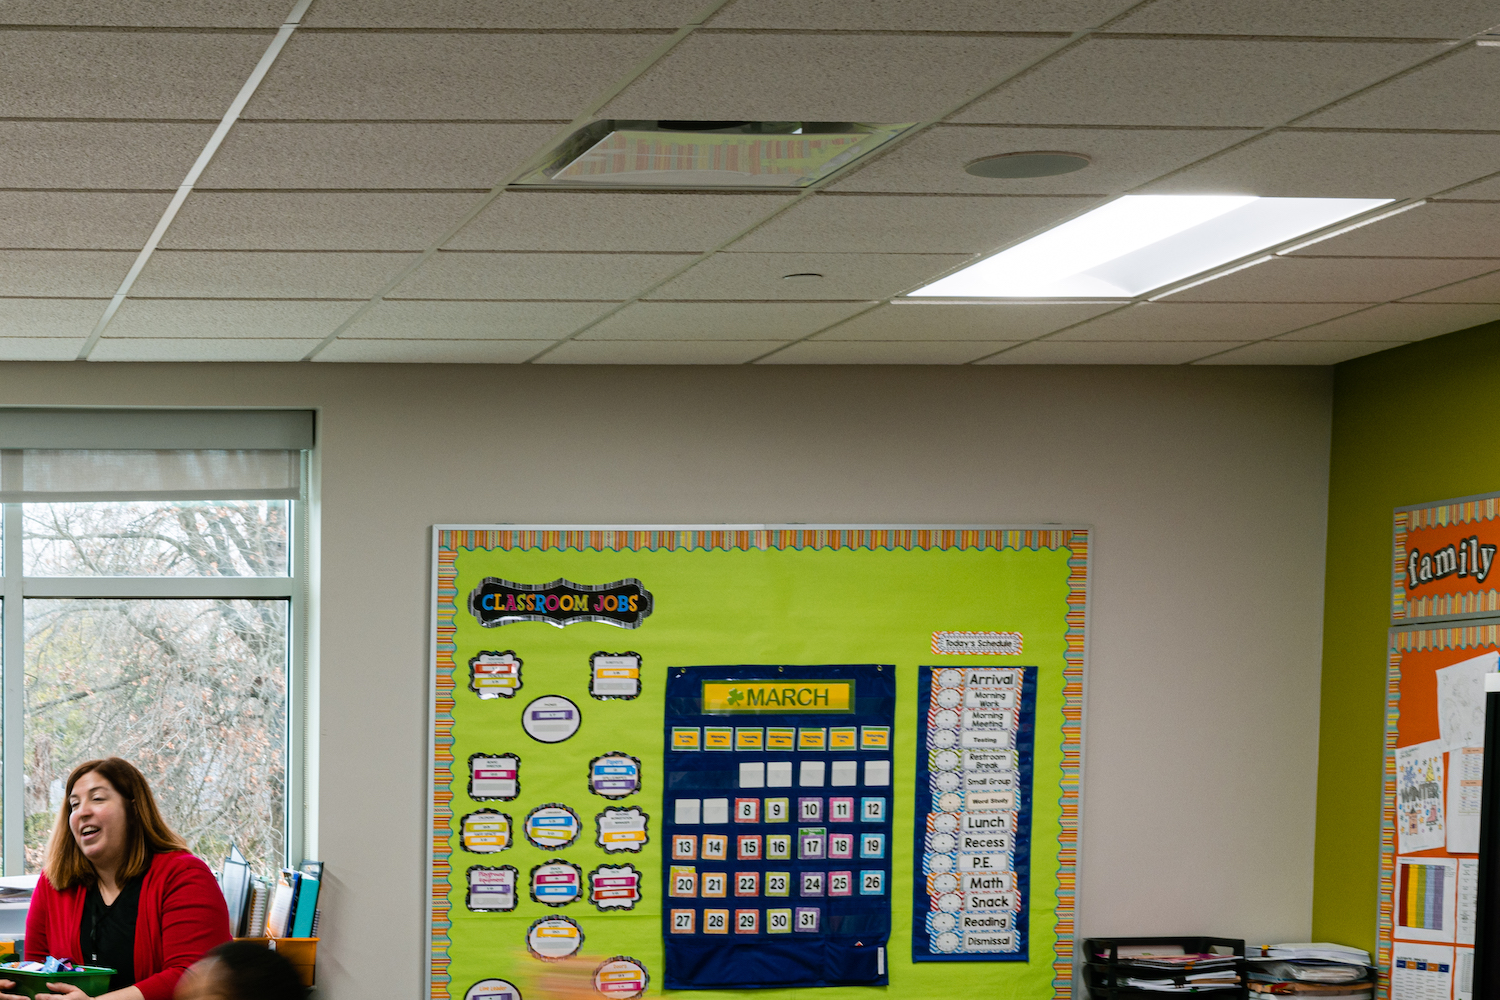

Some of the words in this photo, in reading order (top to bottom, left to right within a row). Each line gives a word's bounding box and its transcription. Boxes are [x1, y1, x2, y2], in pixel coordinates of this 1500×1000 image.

[1406, 536, 1497, 590] family
[481, 593, 589, 613] CLASSROOM
[594, 594, 639, 613] JOBS
[945, 639, 975, 648] Today's
[977, 639, 1012, 648] Schedule
[969, 674, 1013, 686] Arrival
[746, 687, 829, 707] MARCH
[974, 692, 1006, 700] Morning
[972, 711, 1003, 720] Morning
[972, 720, 1003, 728] Meeting
[969, 753, 1007, 761] Restroom
[976, 761, 999, 769] Break
[967, 778, 987, 786] Small
[988, 778, 1011, 787] Group
[743, 804, 751, 815] 8
[773, 804, 781, 816] 9
[804, 804, 818, 816] 10
[836, 804, 847, 815] 11
[867, 804, 880, 815] 12
[968, 816, 1005, 828] Lunch
[678, 841, 691, 853] 13
[708, 841, 721, 853] 14
[743, 841, 756, 853] 15
[772, 841, 785, 853] 16
[806, 841, 819, 852] 17
[834, 840, 847, 852] 18
[866, 840, 879, 852] 19
[964, 837, 1005, 848] Recess
[972, 857, 993, 869] P.E.
[678, 879, 693, 890] 20
[708, 879, 722, 890] 21
[740, 878, 755, 890] 22
[770, 878, 785, 889] 23
[805, 878, 820, 890] 24
[833, 877, 847, 889] 25
[865, 877, 880, 888] 26
[969, 877, 1004, 889] Math
[971, 896, 1009, 908] Snack
[676, 915, 690, 927] 27
[708, 916, 724, 927] 28
[740, 915, 754, 927] 29
[771, 915, 787, 927] 30
[801, 914, 815, 926] 31
[964, 917, 1007, 928] Reading
[968, 936, 1010, 946] Dismissal
